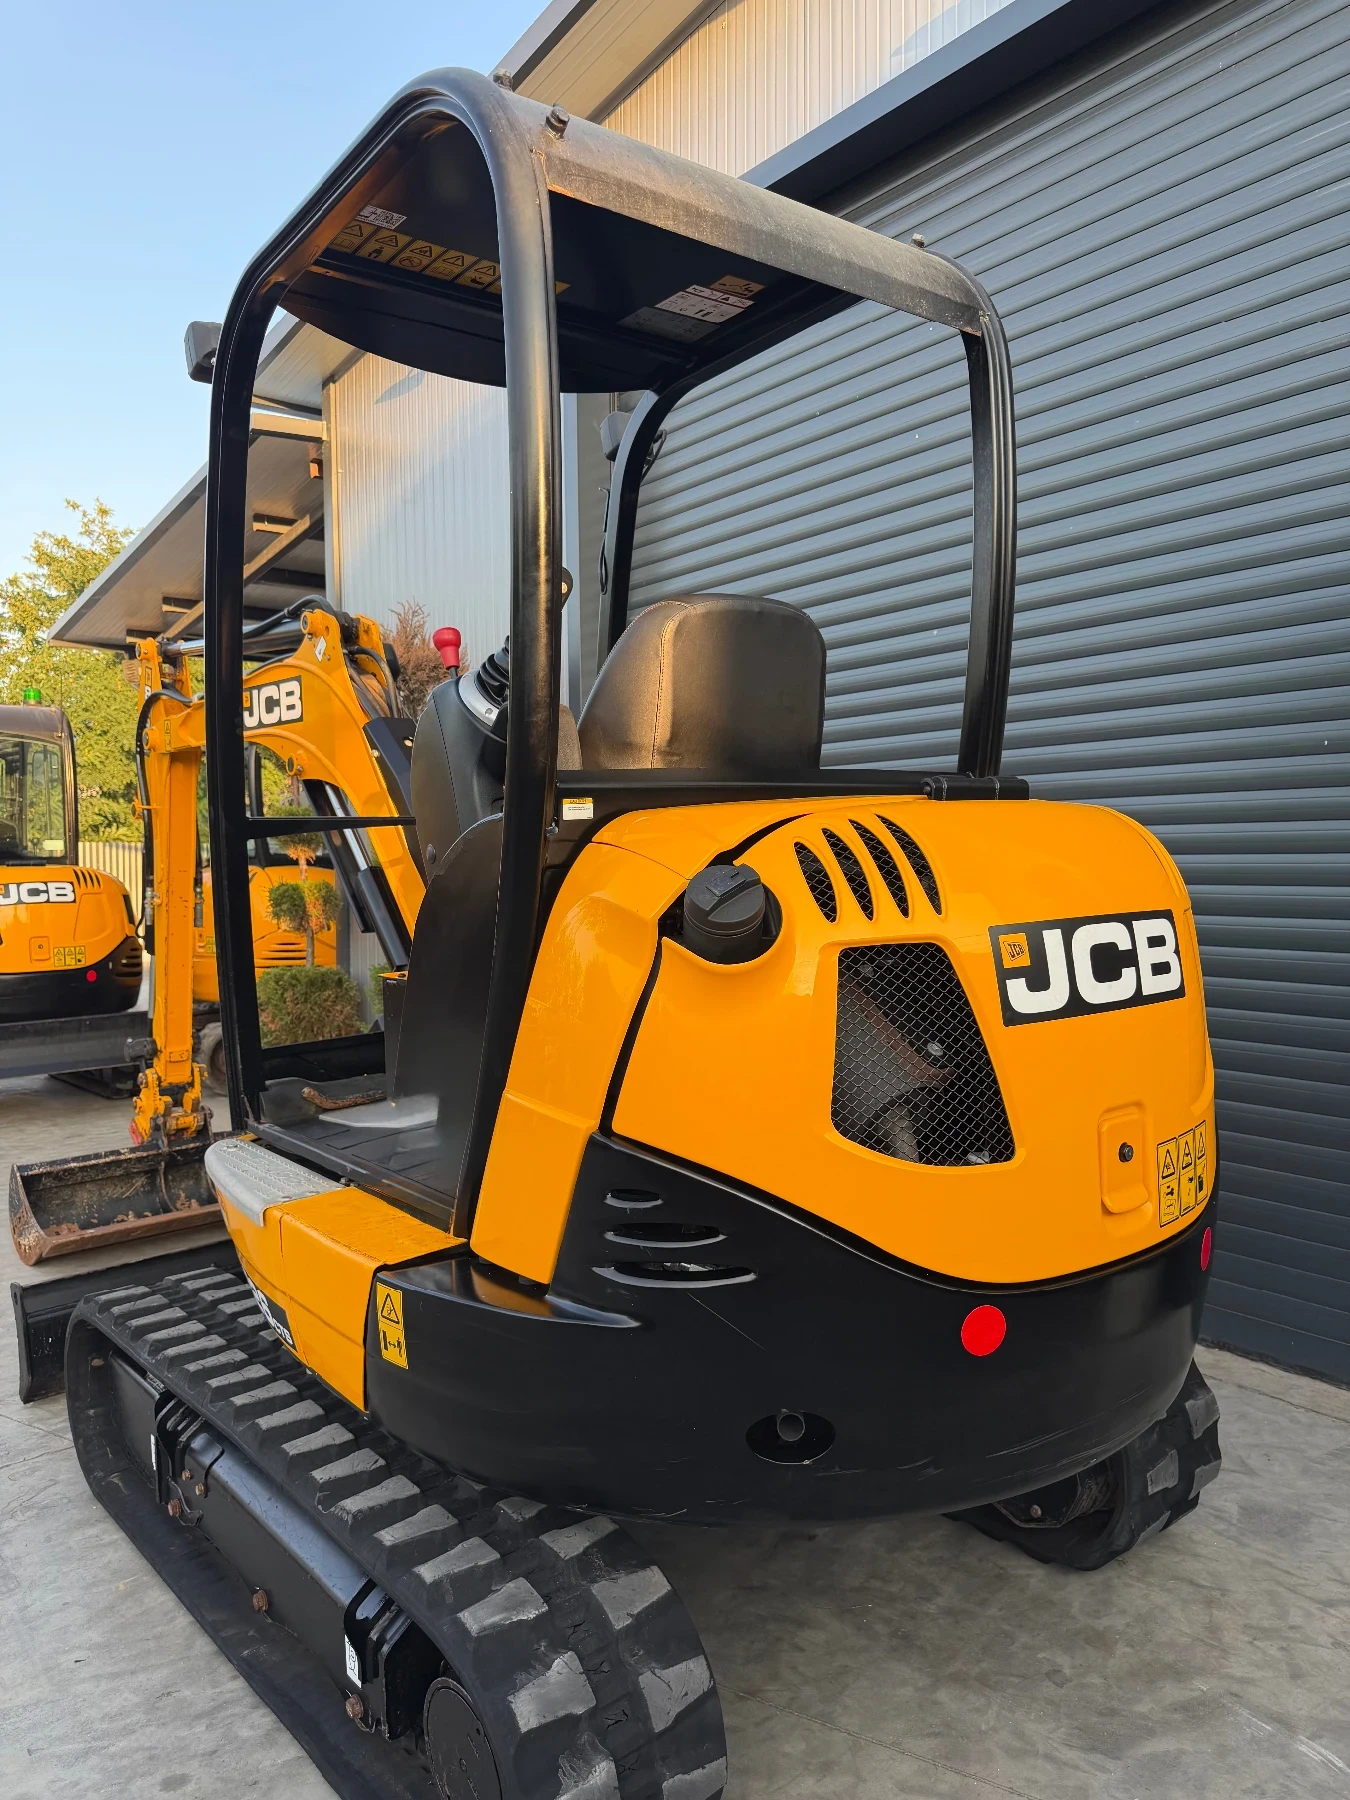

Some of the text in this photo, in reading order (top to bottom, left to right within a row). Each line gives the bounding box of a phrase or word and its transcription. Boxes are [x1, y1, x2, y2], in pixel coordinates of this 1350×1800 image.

[243, 680, 302, 728] JCB
[0, 882, 75, 905] JCB
[1005, 918, 1182, 1014] JCB
[1007, 943, 1025, 958] JCB
